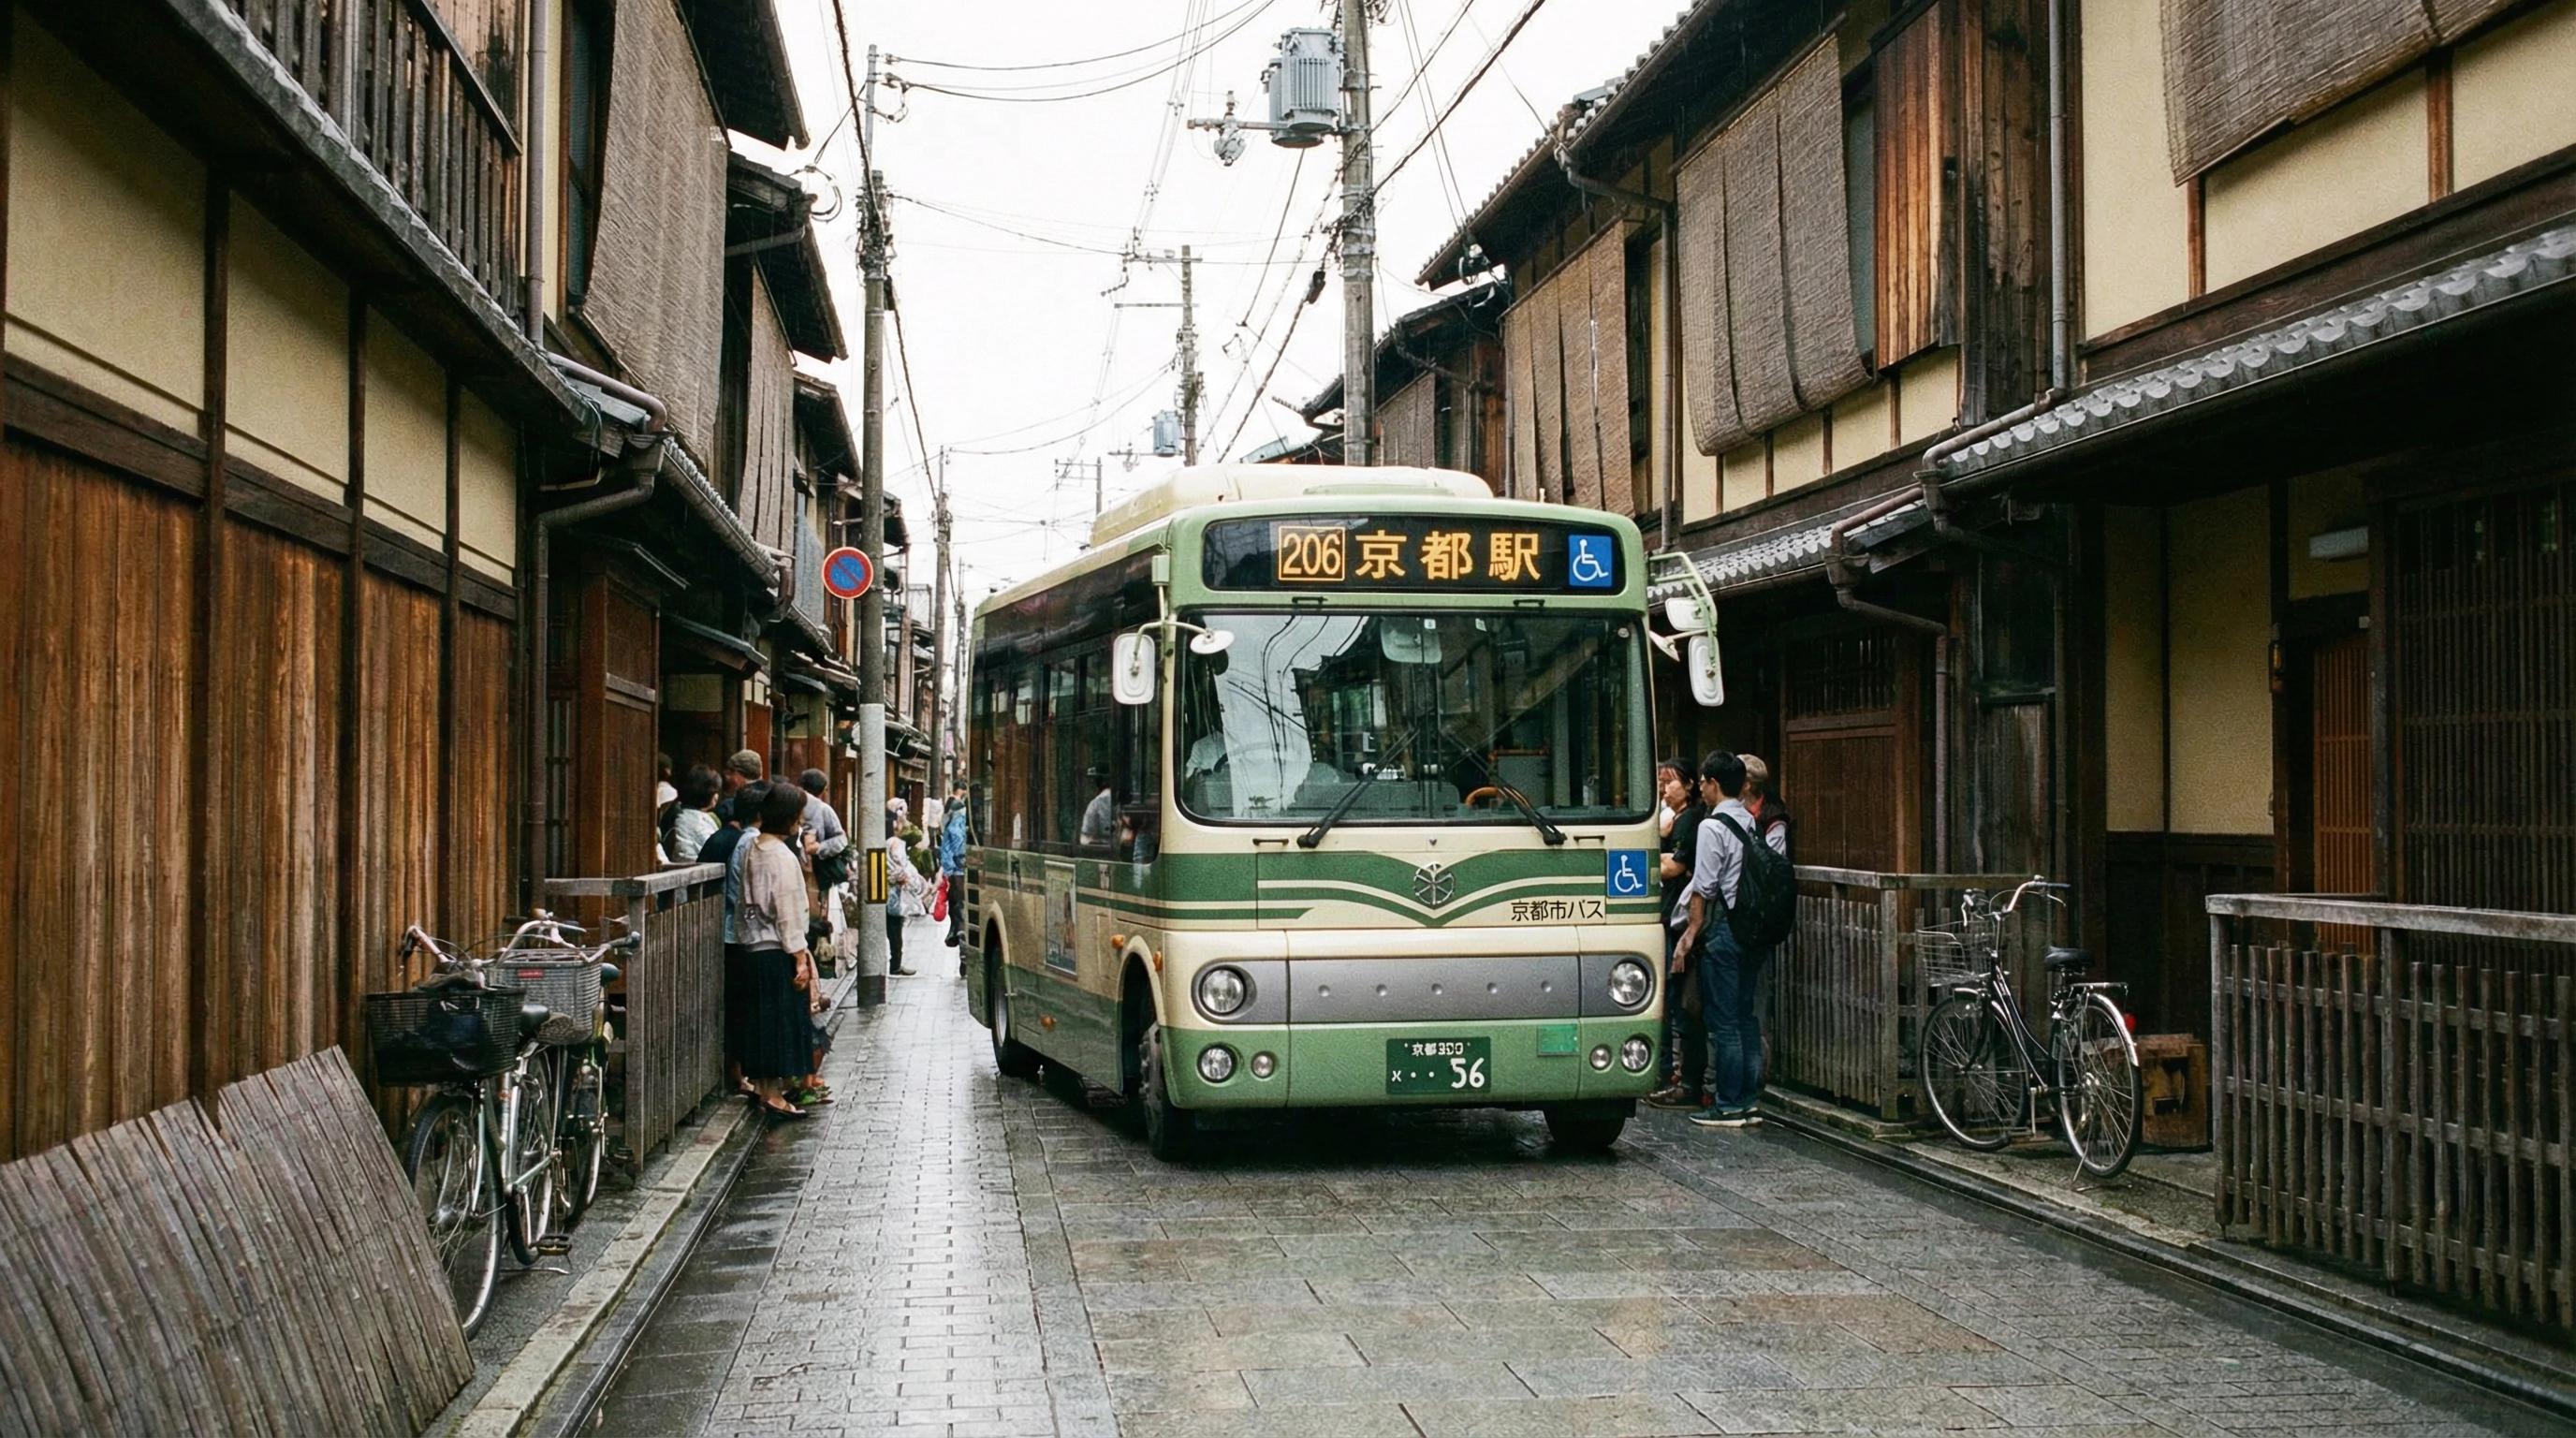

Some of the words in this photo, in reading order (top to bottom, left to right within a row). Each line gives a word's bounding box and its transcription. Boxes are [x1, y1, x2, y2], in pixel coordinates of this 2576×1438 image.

[1282, 532, 1341, 575] 206
[1354, 529, 1540, 580] 京都駅
[1511, 900, 1603, 921] 京都市バス
[1450, 1057, 1485, 1089] 56
